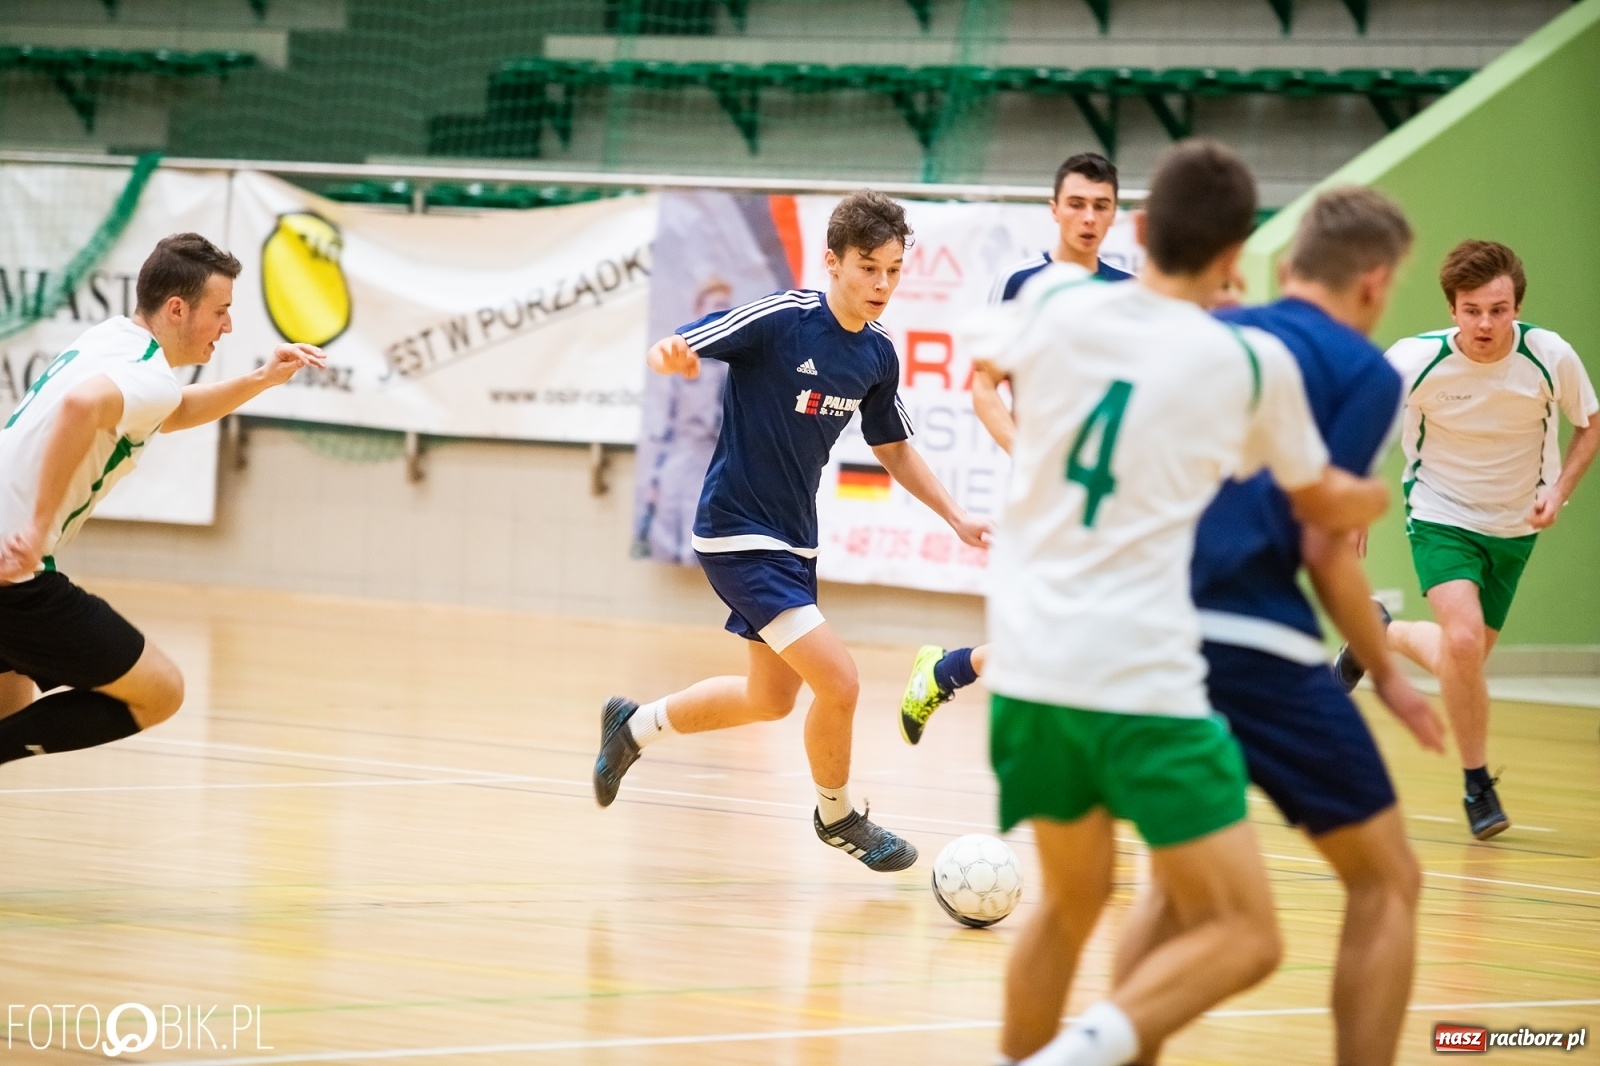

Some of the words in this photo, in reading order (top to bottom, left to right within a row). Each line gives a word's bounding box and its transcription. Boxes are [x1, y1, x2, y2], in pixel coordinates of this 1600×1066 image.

[439, 313, 471, 351] W
[476, 241, 655, 339] PORZĄDK
[1066, 379, 1136, 528] 4
